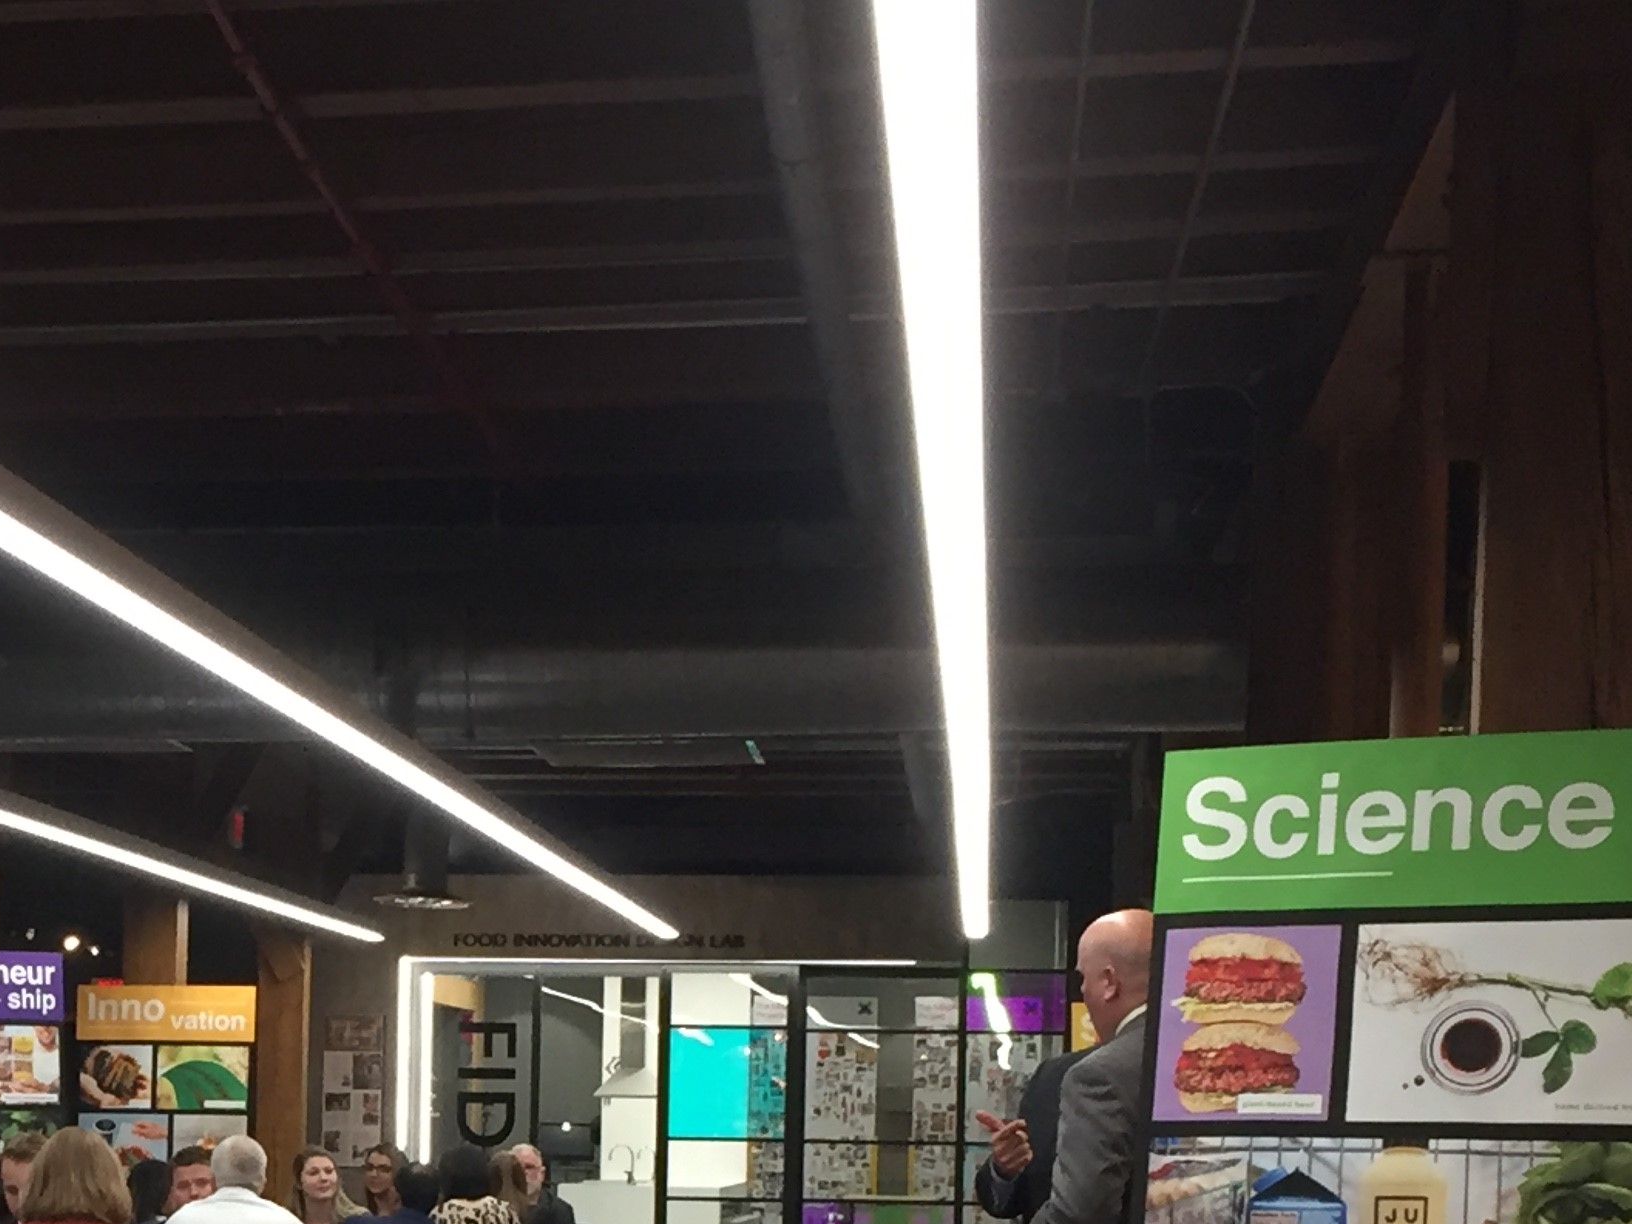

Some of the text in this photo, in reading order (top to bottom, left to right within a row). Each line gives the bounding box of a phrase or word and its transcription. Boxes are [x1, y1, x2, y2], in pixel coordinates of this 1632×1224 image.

[1182, 772, 1615, 861] Science
[453, 933, 507, 947] FOOD
[513, 933, 630, 947] INNOVATION
[709, 934, 745, 948] LAB
[7, 988, 56, 1015] ship
[87, 992, 166, 1022] Inno
[170, 1010, 246, 1031] vation
[457, 1022, 517, 1147] FID
